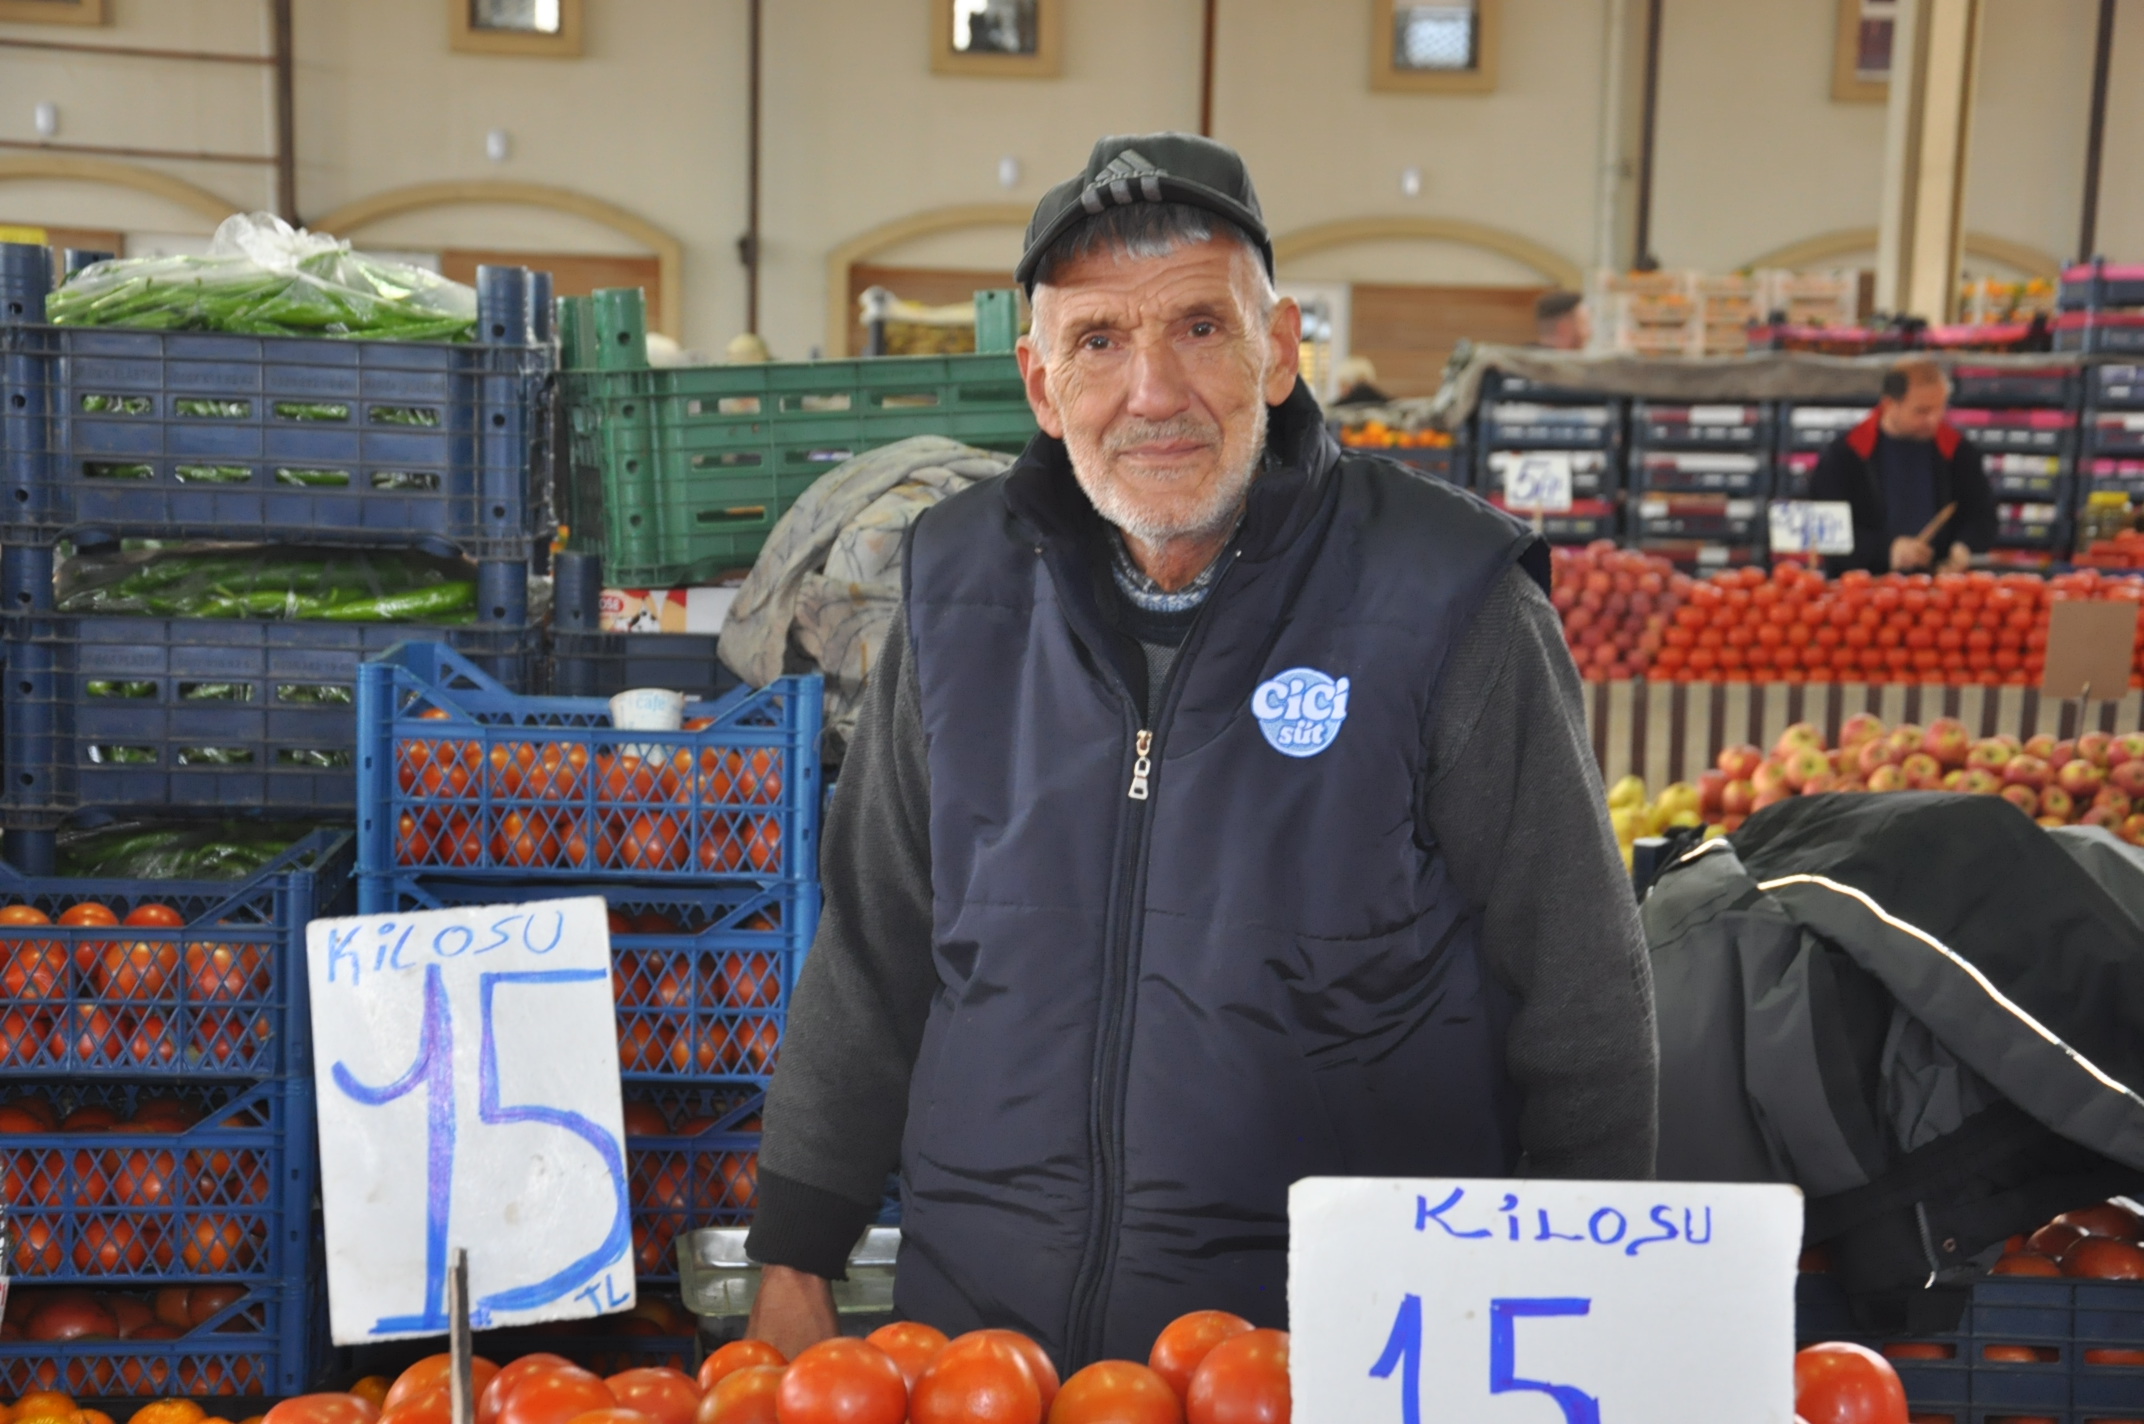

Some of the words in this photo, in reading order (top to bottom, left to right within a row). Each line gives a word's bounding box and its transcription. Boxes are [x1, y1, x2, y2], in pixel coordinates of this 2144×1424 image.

[331, 962, 633, 1335] 15
[575, 1274, 630, 1316] TL
[1369, 1292, 1601, 1424] 15
